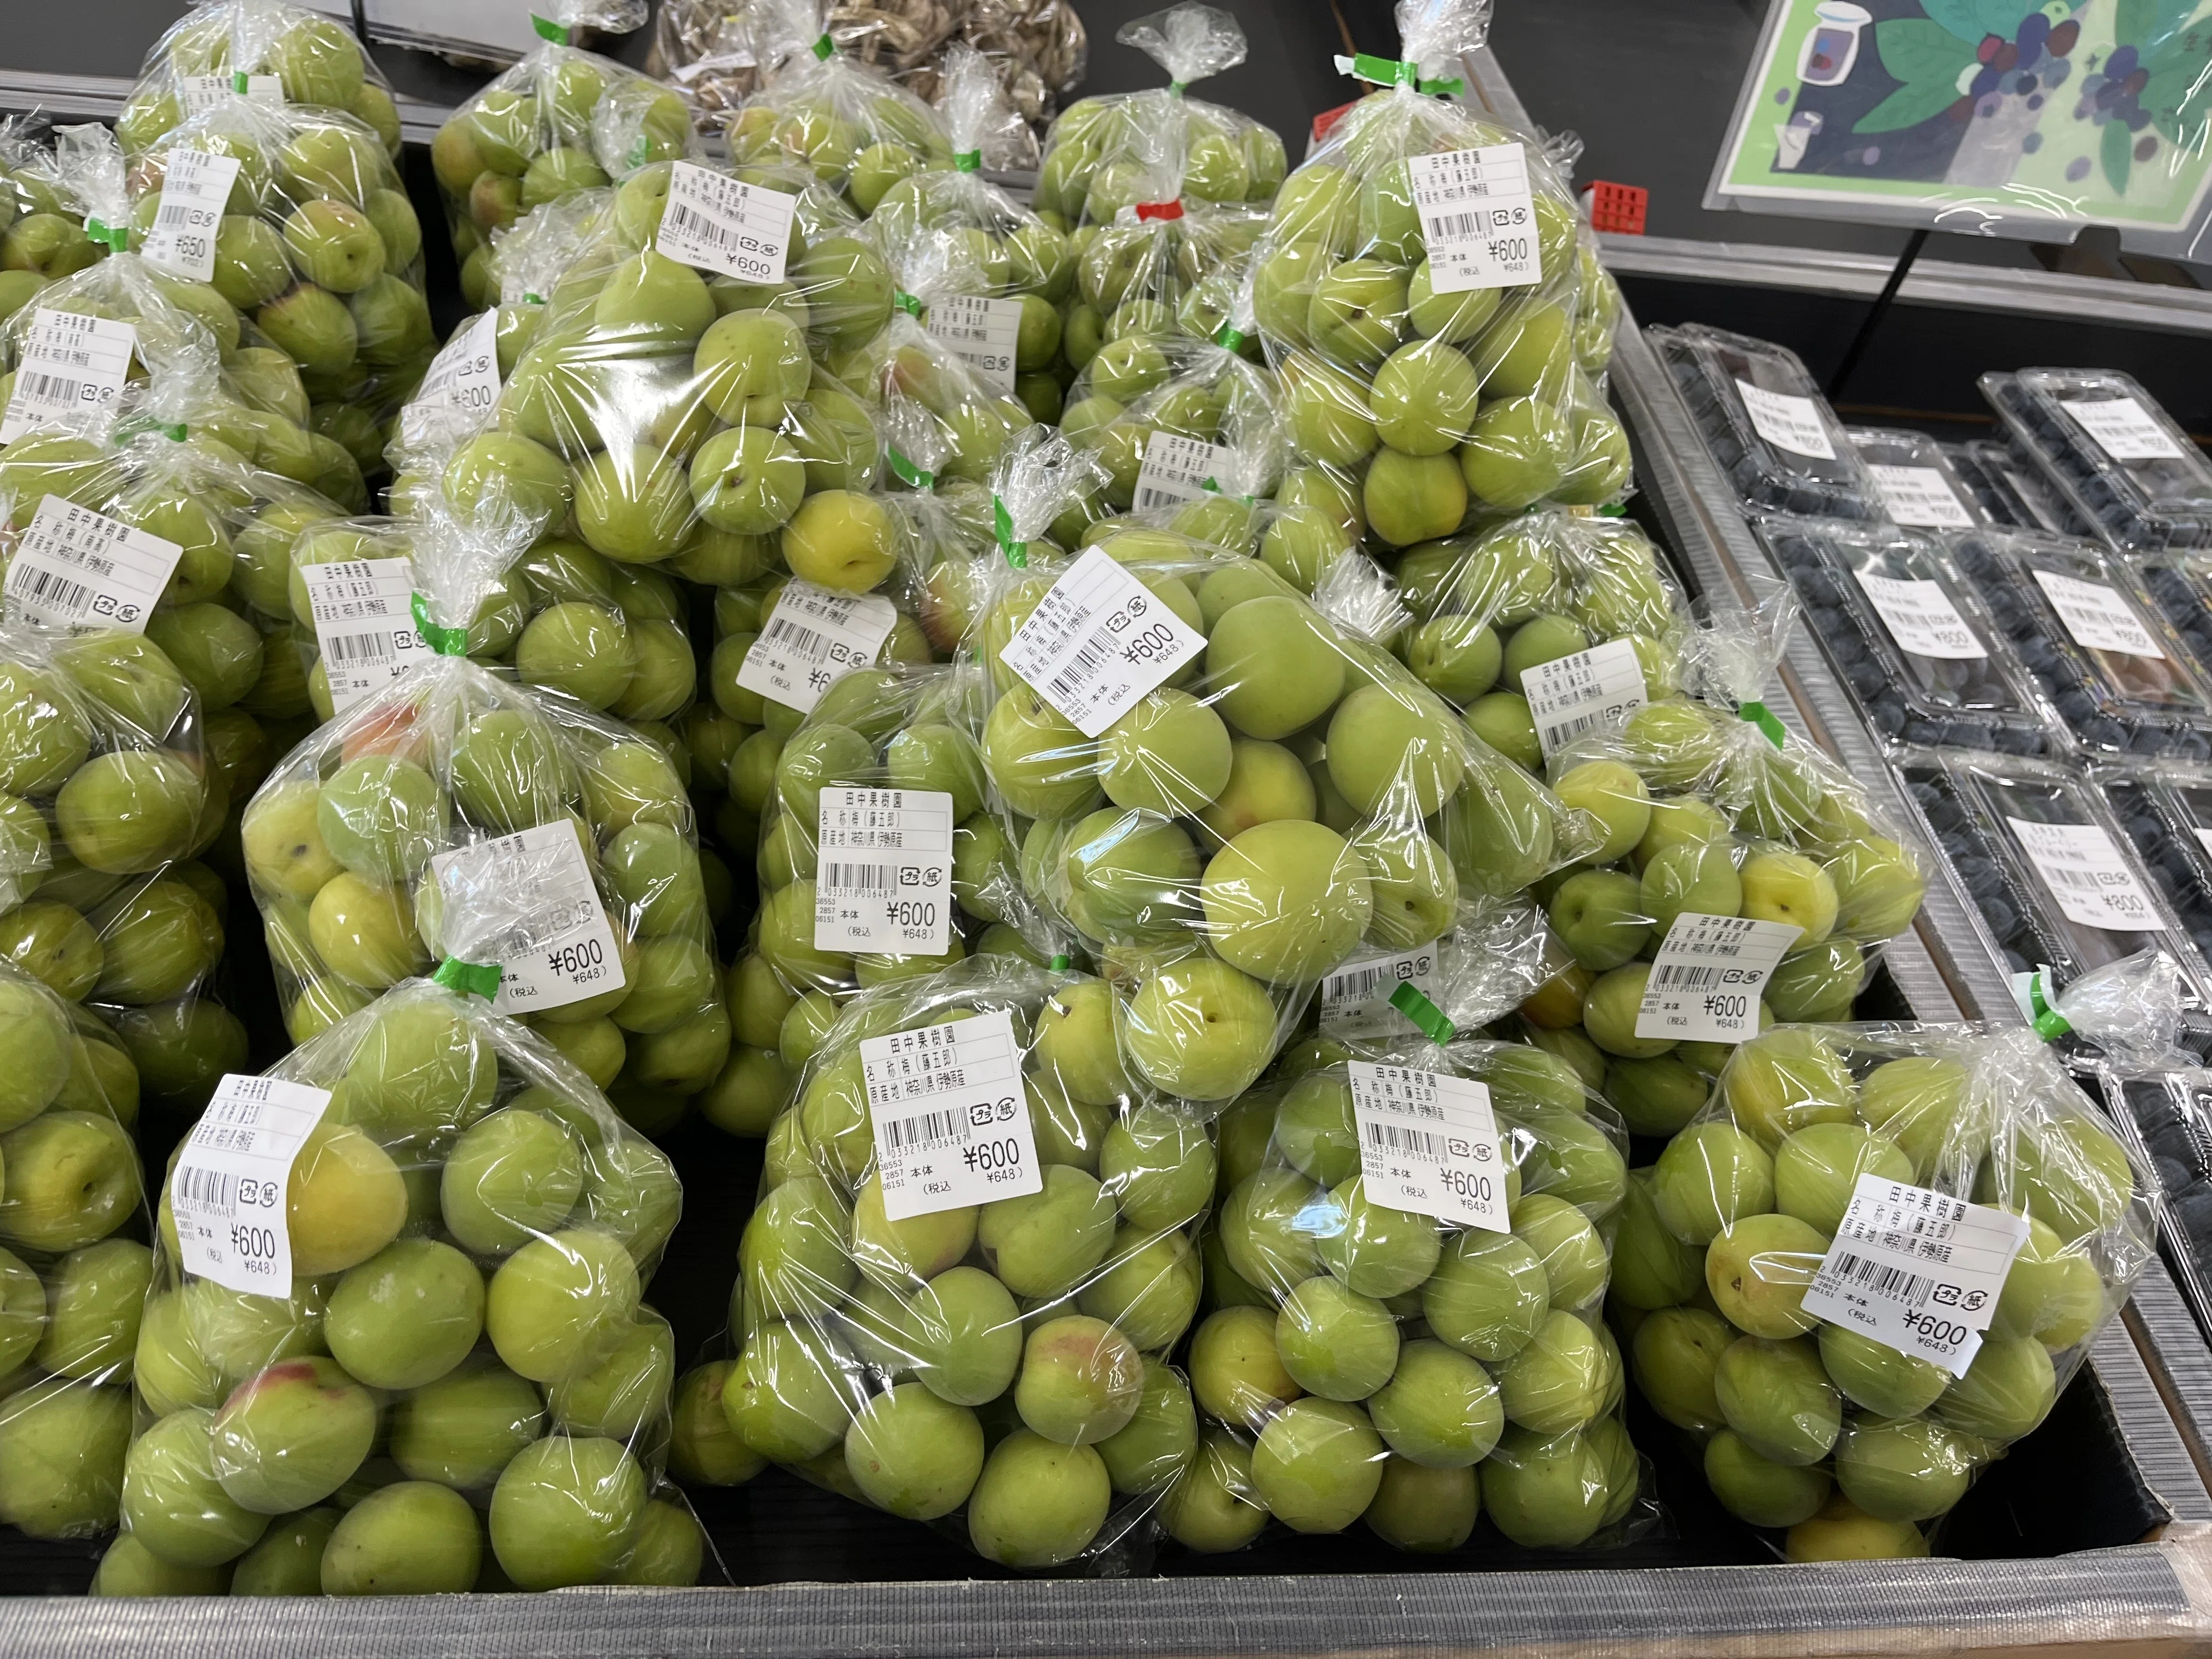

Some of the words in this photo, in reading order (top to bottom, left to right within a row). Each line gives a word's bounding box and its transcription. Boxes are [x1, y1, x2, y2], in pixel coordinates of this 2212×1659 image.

[176, 234, 205, 257] ¥650
[1451, 254, 1466, 262] 本体
[1488, 238, 1527, 261] ¥600
[726, 253, 770, 274] ¥600
[68, 509, 129, 541] 田中果樹園
[1019, 586, 1065, 641] 田中果樹園
[769, 659, 786, 672] 本体
[1090, 684, 1108, 703] 本体
[1119, 623, 1173, 665] ¥600
[1070, 703, 1087, 718] 2857
[1072, 709, 1092, 725] 06151
[847, 792, 901, 808] 田中果樹園
[840, 910, 859, 919] 本体
[887, 902, 935, 927] ¥600
[548, 939, 602, 976] ¥600
[1703, 995, 1746, 1017] ¥600
[891, 1026, 955, 1054] 田中果樹園
[866, 1060, 896, 1081] 名称
[1376, 1068, 1436, 1087] 田中果樹園
[870, 1084, 900, 1104] 原産地
[879, 1160, 902, 1170] 36553
[911, 1165, 933, 1177] 本体
[963, 1138, 1019, 1172] ¥600
[1361, 1152, 1383, 1161] 36553
[1367, 1161, 1383, 1169] 2857
[885, 1170, 903, 1180] 2857
[1363, 1169, 1384, 1178] 06151
[1390, 1167, 1411, 1178] 本体
[1441, 1167, 1491, 1201] ¥600
[882, 1180, 905, 1190] 06151
[1889, 1186, 1966, 1221] 田中果樹園
[232, 1223, 274, 1259] ¥600
[1816, 1273, 1842, 1286] 36553
[1818, 1280, 1839, 1291] 2857
[1810, 1285, 1834, 1298] 06151
[1844, 1293, 1869, 1307] 本体
[1903, 1309, 1966, 1345] ¥600
